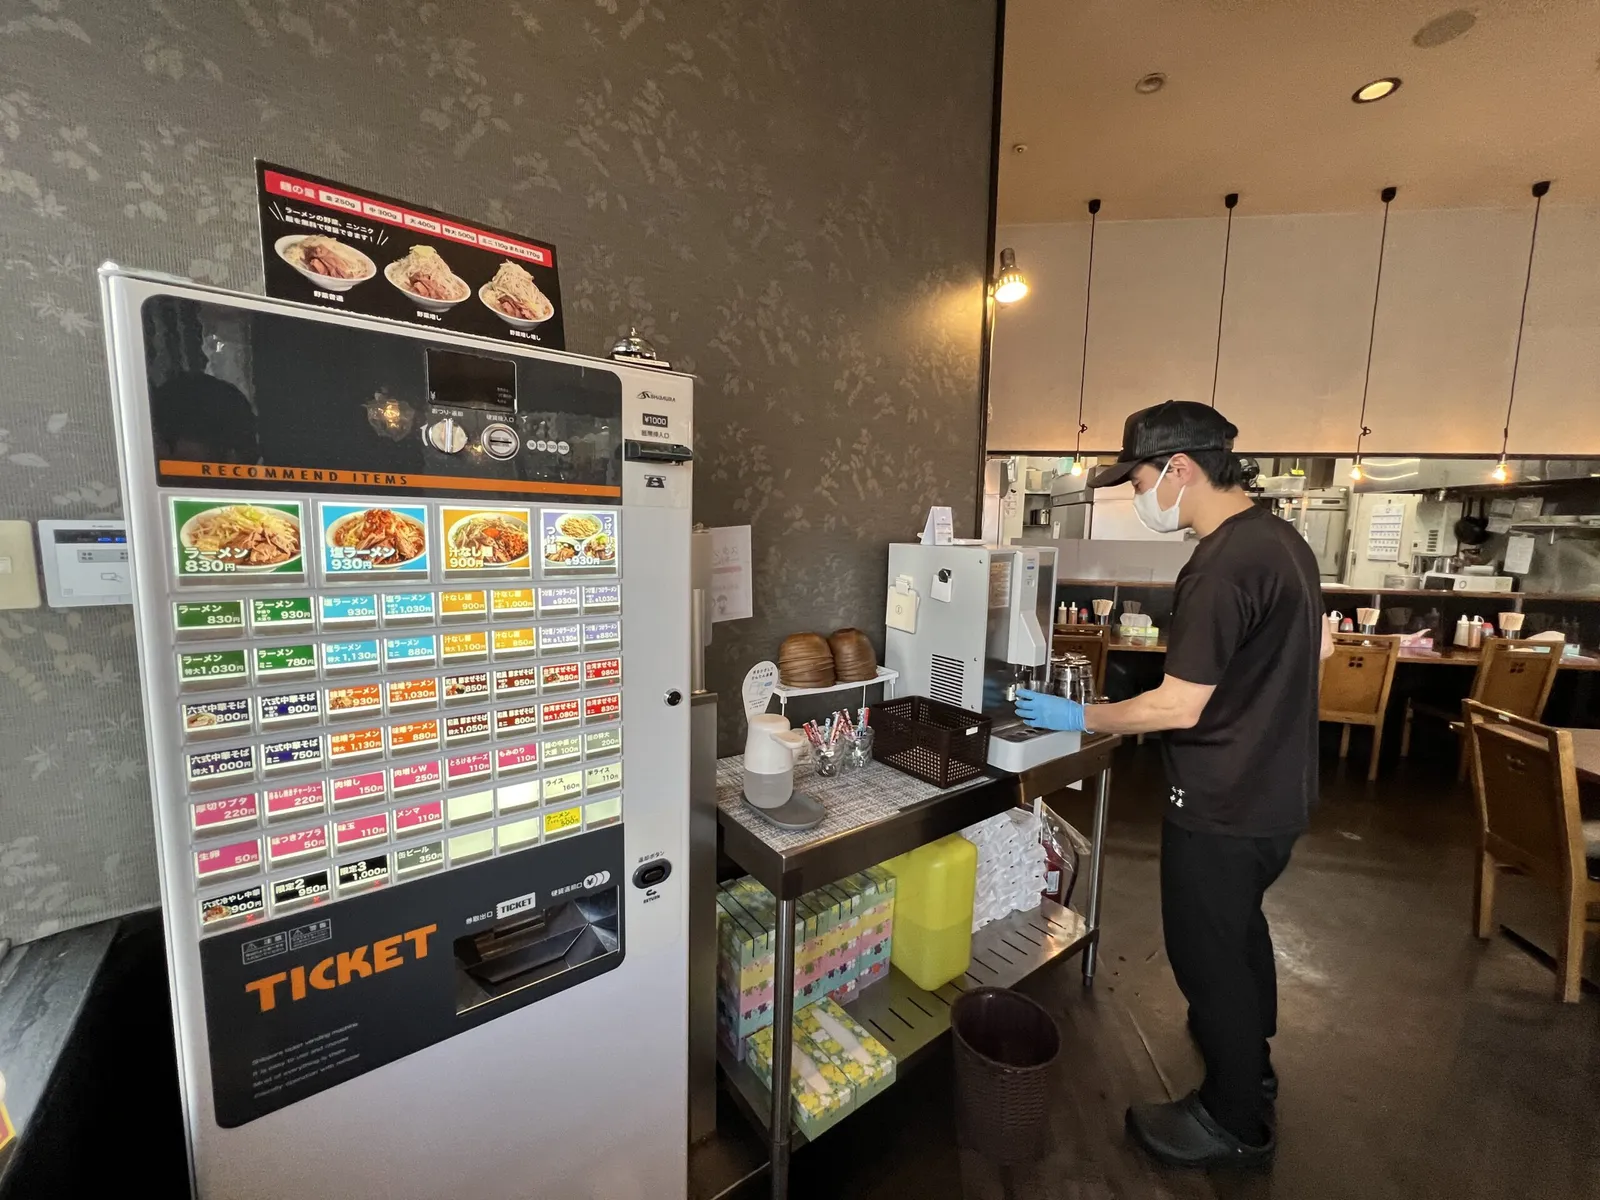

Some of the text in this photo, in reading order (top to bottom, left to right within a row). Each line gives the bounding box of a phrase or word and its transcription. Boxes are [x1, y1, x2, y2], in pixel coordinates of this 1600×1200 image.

[335, 196, 356, 208] 250g
[378, 208, 399, 219] 300g
[417, 219, 436, 230] 400g
[457, 230, 476, 241] 500g
[644, 416, 667, 426] ¥1000
[201, 463, 408, 486] RECOMMEND ITEMS
[184, 547, 250, 560] ラーメン
[329, 546, 396, 560] 塩ラーメン
[184, 559, 236, 572] 830円
[331, 559, 373, 570] 930円
[450, 557, 484, 568] 900円
[179, 604, 223, 615] ラーメン
[255, 600, 294, 610] ラーメン
[399, 605, 432, 614] 1,030円
[462, 602, 485, 610] 900円
[280, 610, 311, 620] 930円
[347, 608, 375, 617] 930円
[207, 614, 241, 625] 830円
[258, 649, 294, 659] ラーメン
[342, 652, 377, 662] 1,130円
[408, 648, 433, 656] 880円
[183, 654, 223, 665] ラーメン
[259, 658, 315, 669] ミニ 780円
[601, 668, 618, 676] 980円
[465, 684, 488, 692] 850円
[514, 678, 535, 687] 950円
[262, 692, 316, 706] 六式中華そば
[404, 690, 435, 700] 1,030円
[187, 700, 247, 715] 六式中華そば
[353, 698, 380, 706] 930円
[287, 704, 317, 714] 900円
[216, 712, 248, 723] 800円
[514, 716, 536, 725] 800円
[412, 731, 437, 741] 880円
[264, 737, 319, 753] 六式中華そば
[350, 741, 381, 751] 1,130円
[560, 746, 579, 754] 100円
[191, 748, 250, 765] 六式中華そば
[267, 750, 320, 764] ミニ 750円
[499, 747, 525, 758] もみのり
[450, 753, 489, 767] とろけるチーズ
[517, 754, 536, 763] 110円
[208, 760, 251, 773] 1,000円
[419, 764, 428, 773] W
[469, 763, 490, 772] 110円
[335, 778, 360, 789] 肉増し
[415, 773, 439, 783] 250円
[546, 777, 564, 787] ライス
[359, 784, 384, 795] 150円
[563, 782, 580, 791] 160円
[196, 796, 248, 814] 厚切りブタ
[294, 795, 323, 806] 220円
[223, 807, 255, 819] 220円
[397, 807, 420, 818] メンマ
[418, 812, 440, 823] 110円
[271, 828, 322, 846] 味つきアブラ
[361, 826, 385, 837] 110円
[303, 838, 325, 849] 50円
[398, 845, 430, 859] 缶ビール
[419, 852, 443, 863] 350円
[234, 853, 258, 864] 50円
[340, 861, 367, 876] 限定3
[352, 867, 387, 881] 1,000円
[275, 878, 306, 894] 限定2
[298, 884, 327, 897] 950円
[202, 888, 261, 909] 六式冷やし中華
[643, 894, 661, 904] RETURN
[231, 900, 262, 914] 900円
[501, 898, 534, 914] TICKET
[245, 923, 437, 1013] TICKET
